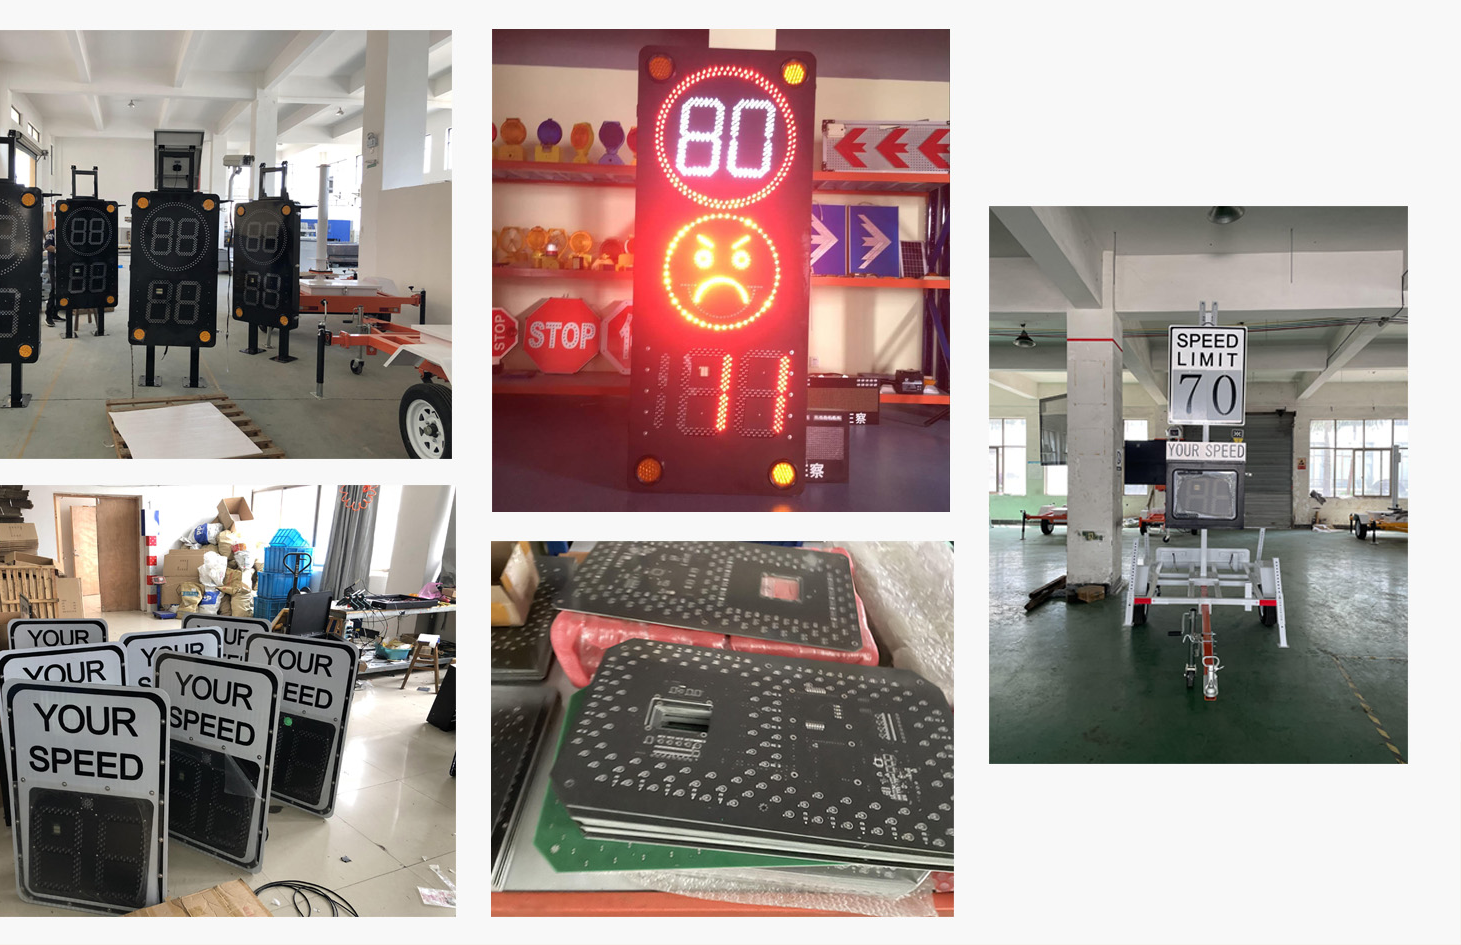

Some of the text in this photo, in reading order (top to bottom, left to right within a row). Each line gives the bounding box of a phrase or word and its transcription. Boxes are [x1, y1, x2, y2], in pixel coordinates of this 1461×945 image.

[675, 96, 777, 179] 80
[494, 314, 505, 351] STOP
[528, 321, 596, 349] STOP
[1176, 333, 1239, 348] SPEED
[1177, 352, 1238, 367] LIMIT
[1179, 374, 1237, 416] 70
[1168, 443, 1245, 458] YOUR SPEED
[805, 462, 825, 479] 察
[27, 629, 89, 647] YOUR
[22, 659, 106, 684] YOUR
[263, 646, 333, 678] YOUR
[175, 671, 253, 711] YOUR
[283, 682, 333, 710] EED
[33, 703, 138, 737] YOUR
[170, 705, 255, 747] SPEED
[29, 745, 144, 781] SPEED
